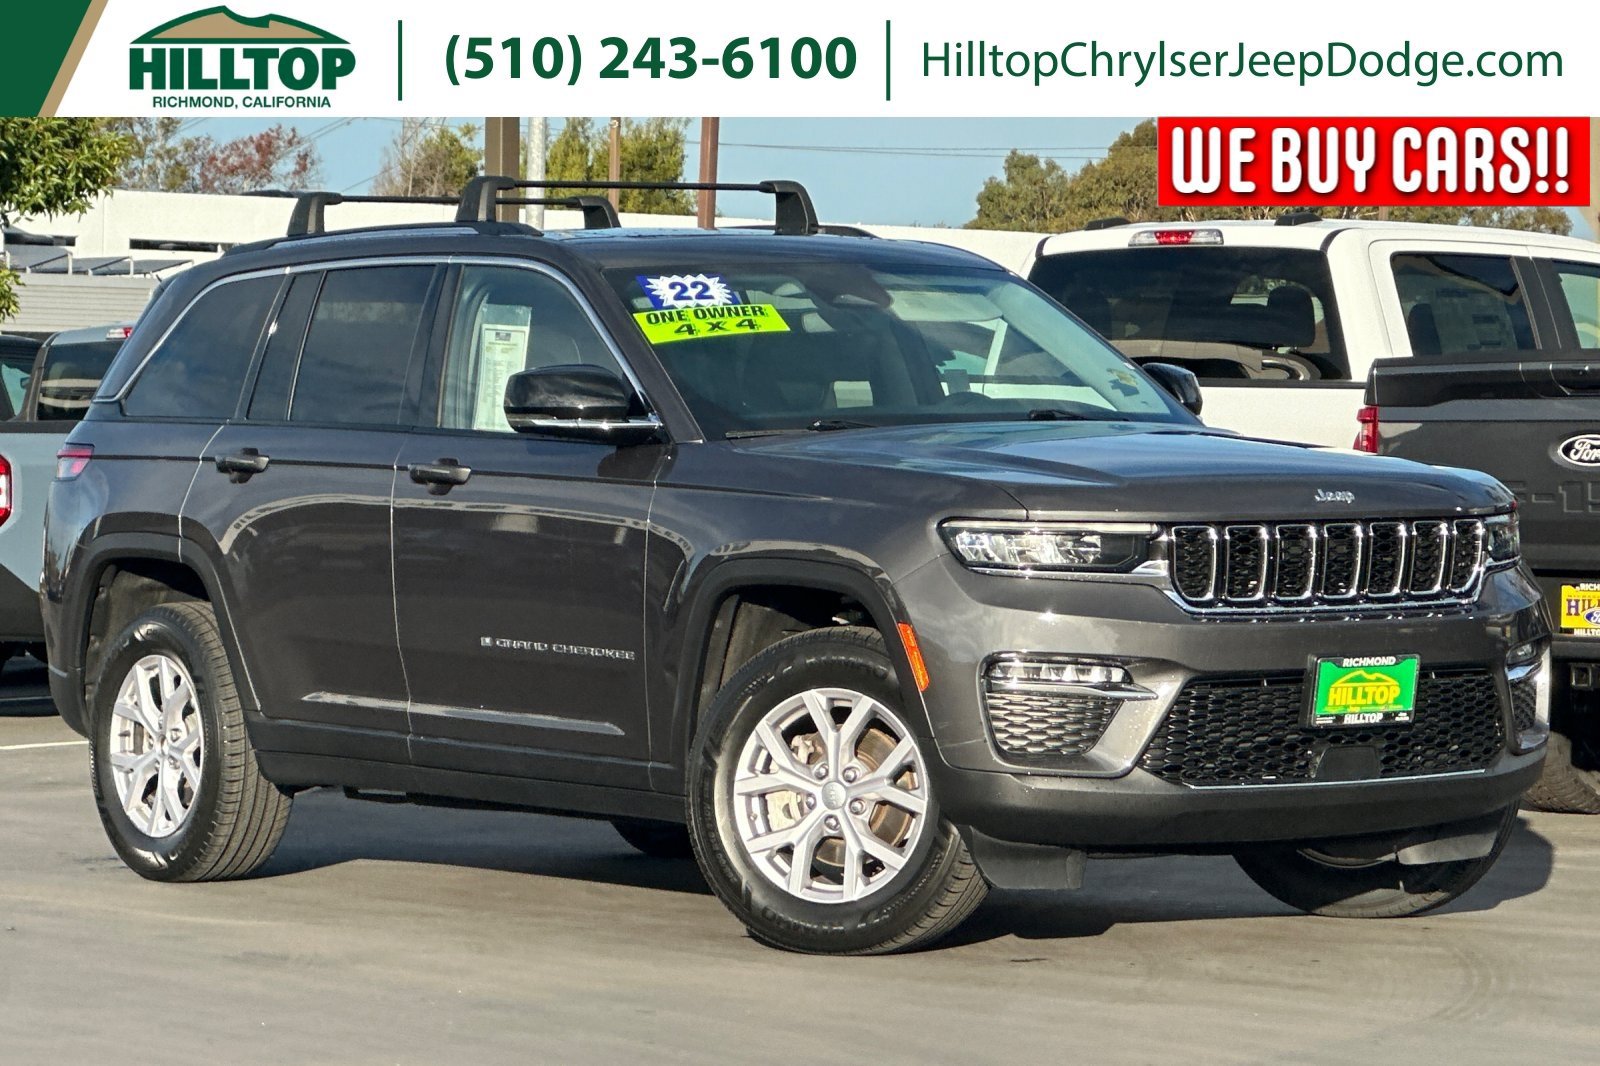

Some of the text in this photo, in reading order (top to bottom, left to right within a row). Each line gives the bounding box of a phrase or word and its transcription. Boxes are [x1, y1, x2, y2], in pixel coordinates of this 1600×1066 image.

[668, 281, 715, 301] 22
[646, 305, 766, 325] ONE OWNER
[1314, 488, 1356, 504] Jeep
[495, 638, 635, 660] GRAND CHEROKEE
[1342, 656, 1397, 668] RICHMOND
[1328, 685, 1401, 706] HILLTOP
[1343, 712, 1384, 724] HILLTOP
